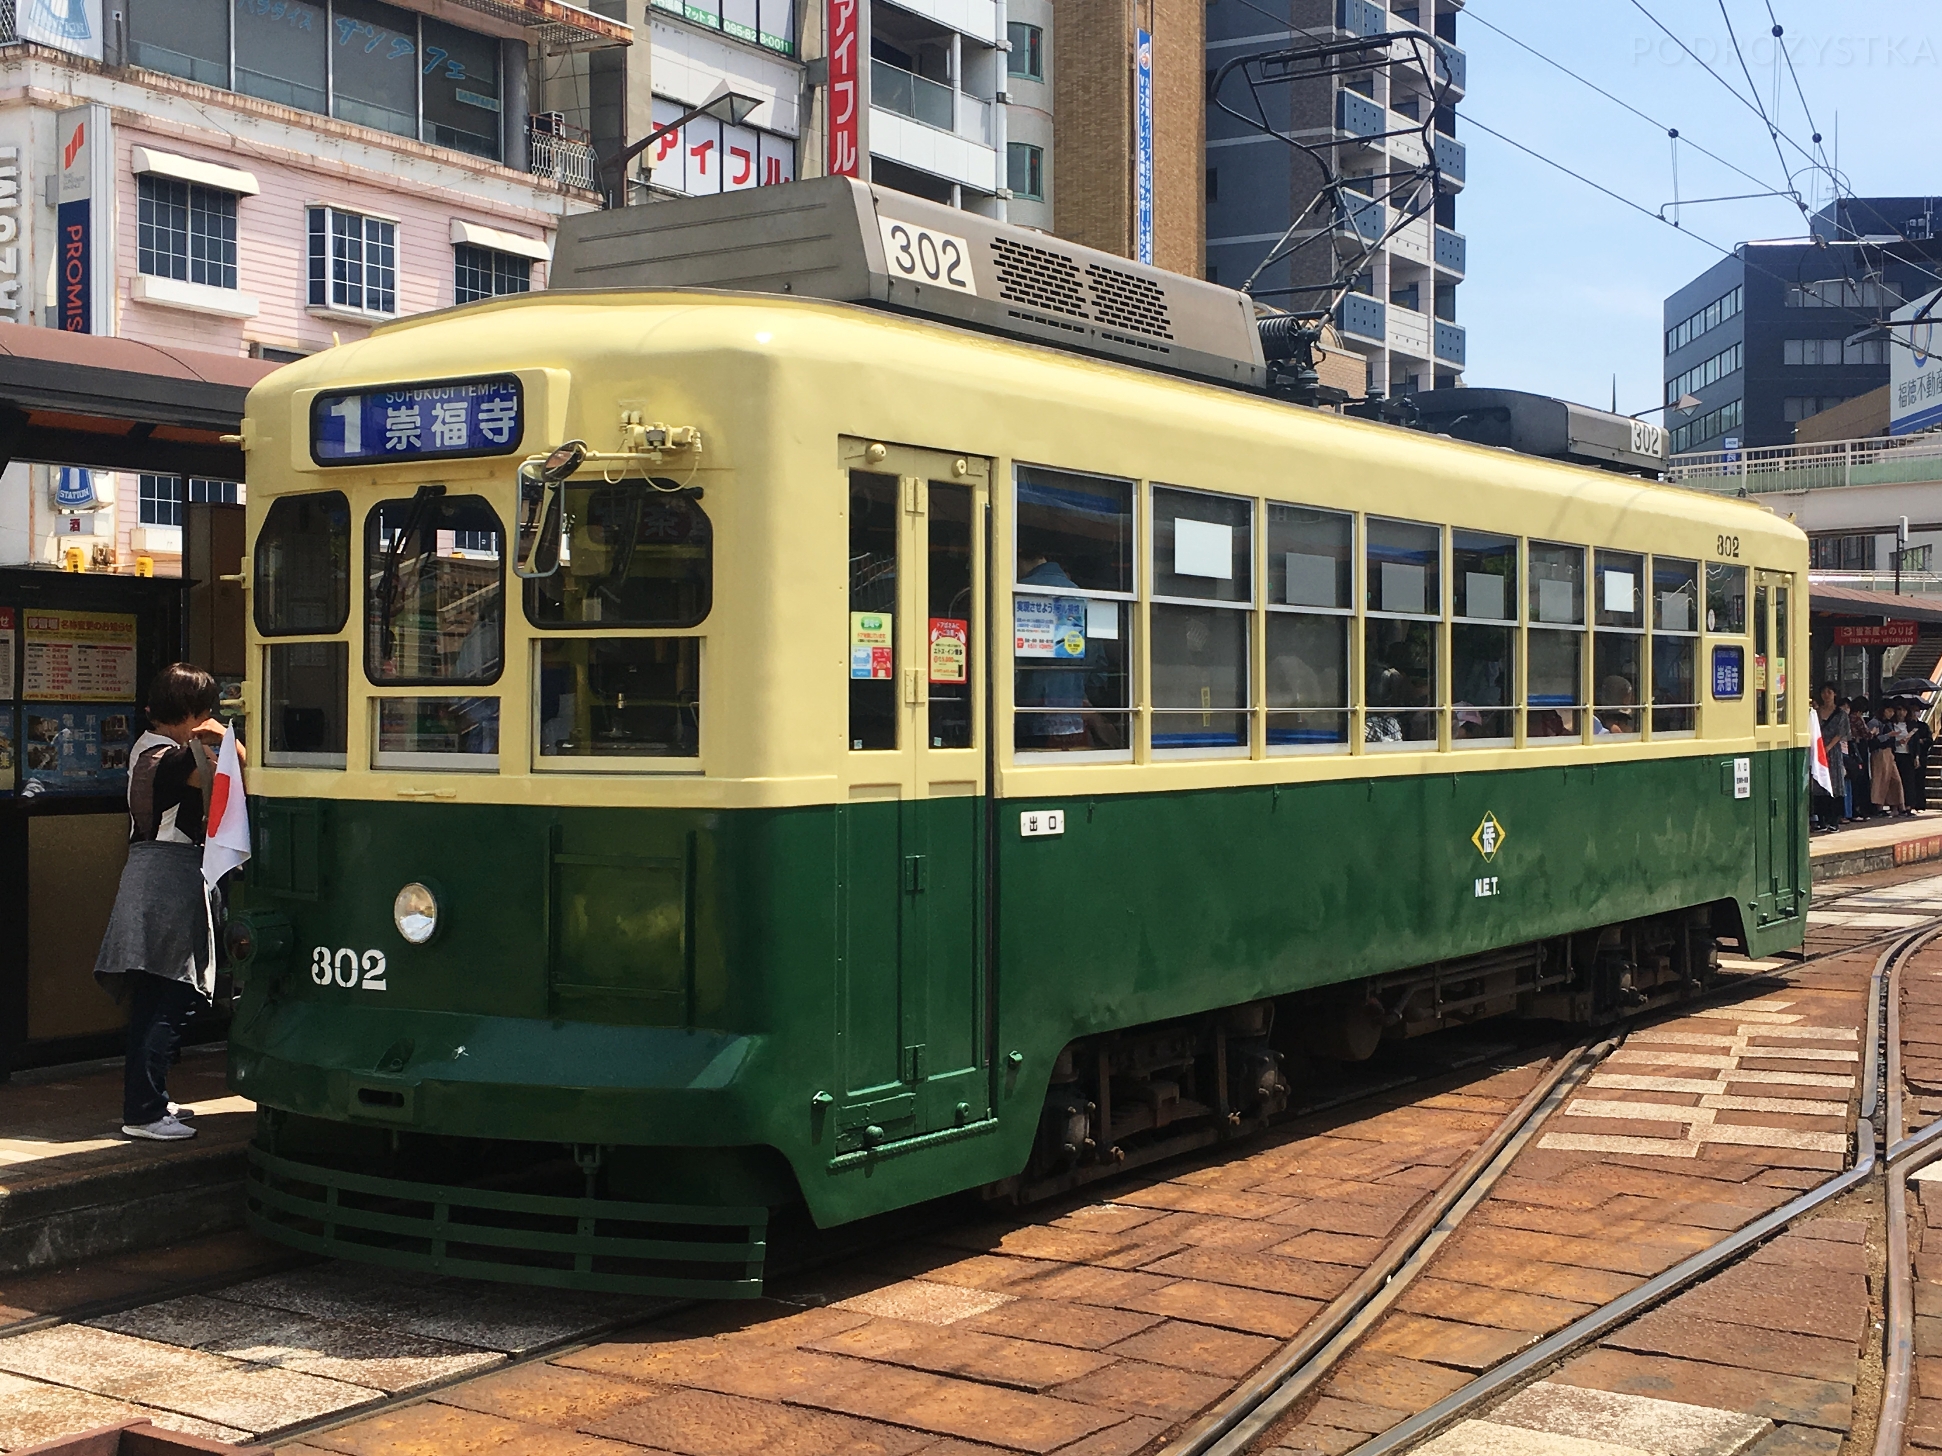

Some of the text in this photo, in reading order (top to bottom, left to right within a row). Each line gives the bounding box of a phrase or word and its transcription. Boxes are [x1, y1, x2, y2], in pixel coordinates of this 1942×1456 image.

[834, 0, 856, 174] アイフル
[652, 121, 790, 186] アイフル
[891, 225, 967, 288] 302
[385, 382, 517, 404] SOFUKUJI TEMPLE
[331, 395, 362, 453] 1
[385, 396, 518, 450] 崇福寺
[1634, 422, 1660, 455] 302
[60, 487, 90, 500] STATION
[1716, 534, 1740, 558] 302
[1716, 665, 1739, 692] 崇福寺
[1029, 815, 1057, 832] 出口
[311, 946, 387, 991] 302
